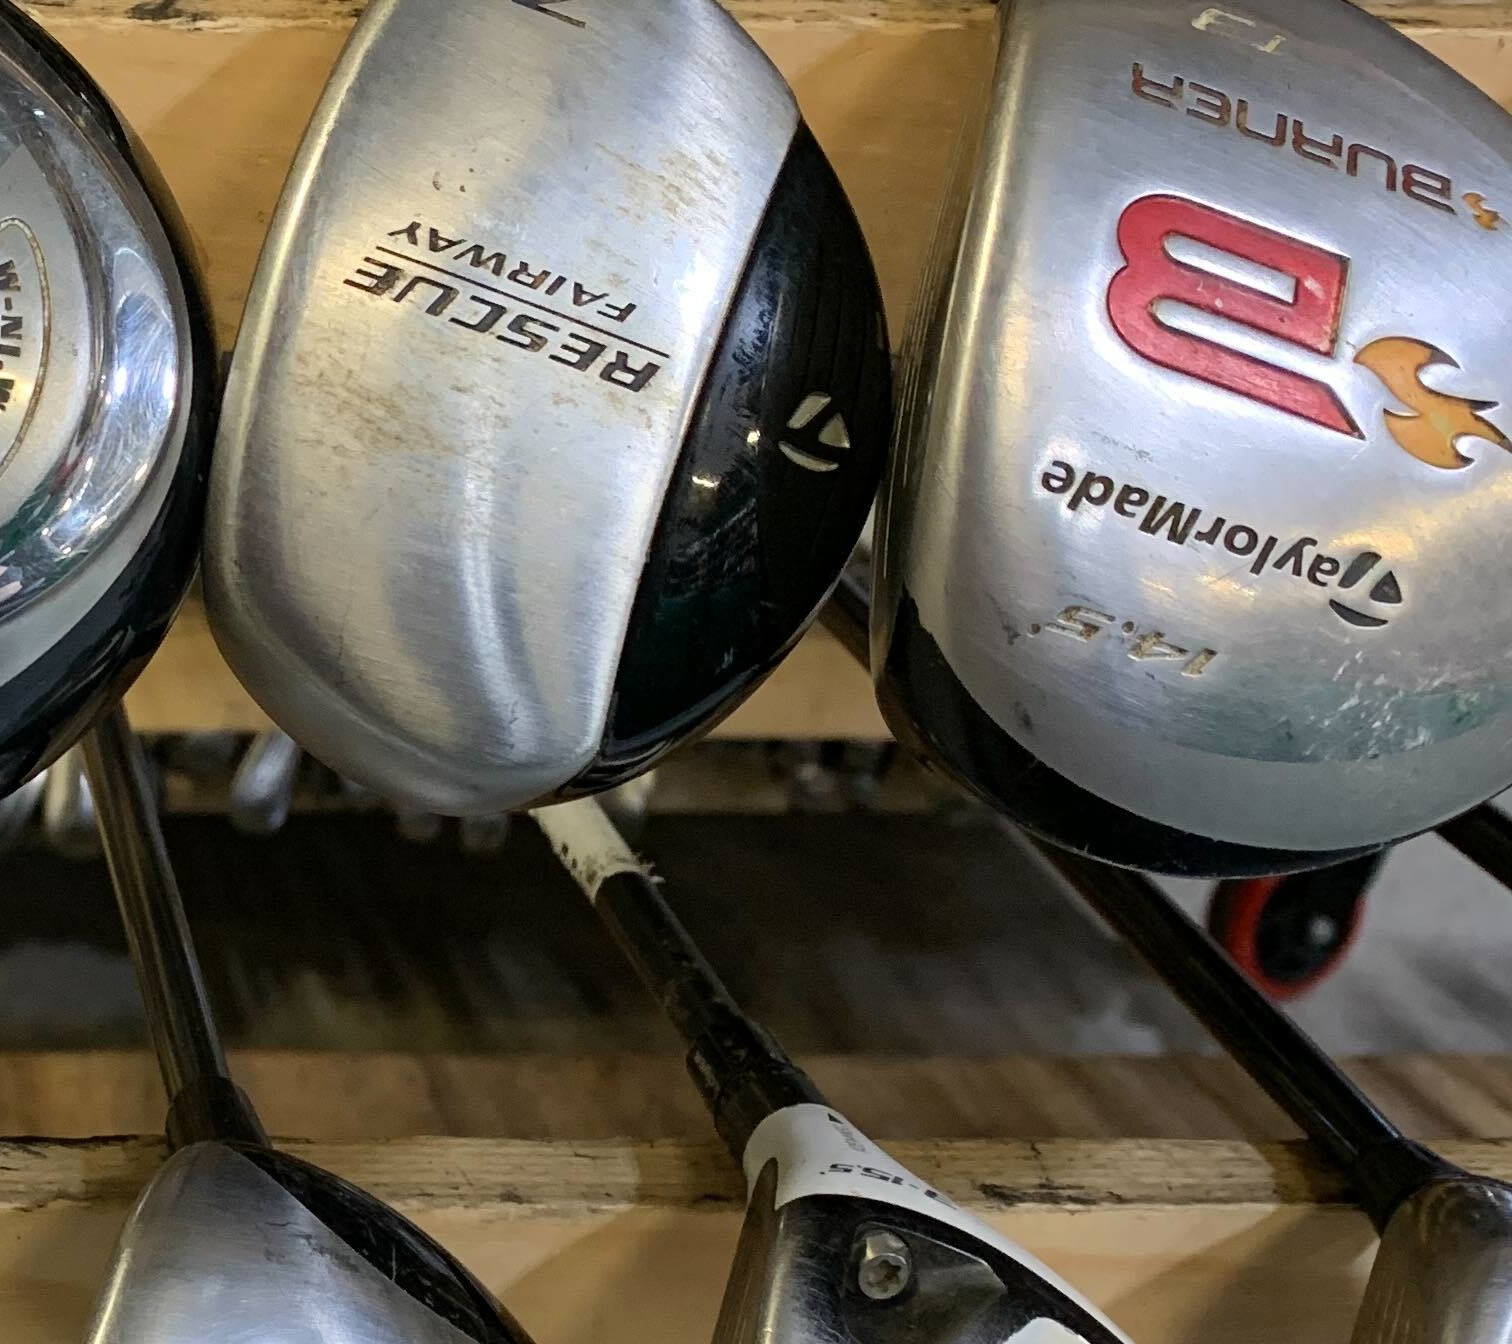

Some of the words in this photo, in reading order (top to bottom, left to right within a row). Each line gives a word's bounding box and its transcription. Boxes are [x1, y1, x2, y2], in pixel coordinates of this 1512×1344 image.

[1132, 61, 1454, 214] BURNER
[343, 256, 660, 394] RESCUE
[388, 218, 638, 323] FAIRWAY
[1039, 458, 1404, 628] TaylorMade
